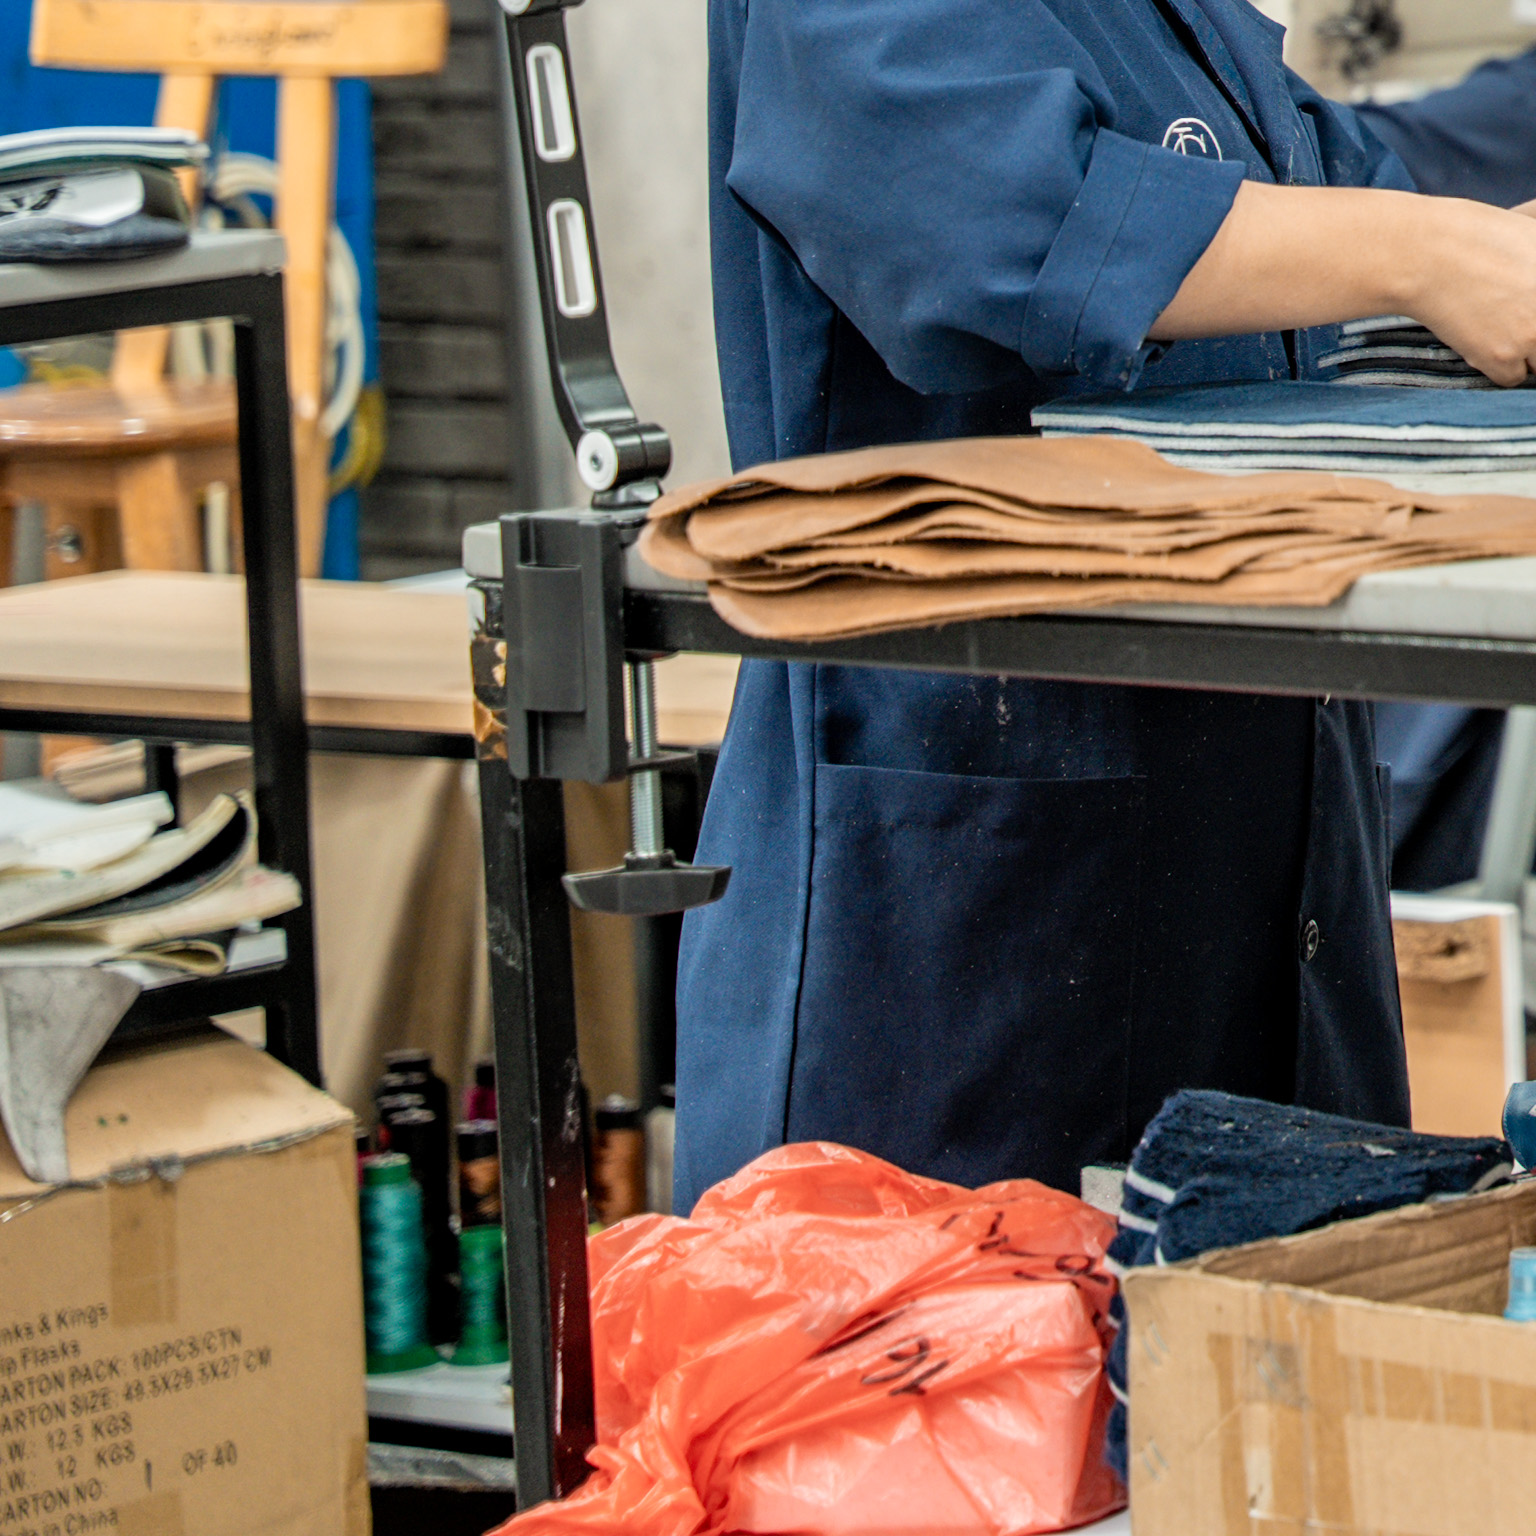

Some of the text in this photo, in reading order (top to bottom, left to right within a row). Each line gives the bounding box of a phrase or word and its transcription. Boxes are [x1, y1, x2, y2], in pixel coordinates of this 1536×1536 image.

[56, 1303, 108, 1329] Kings
[244, 1344, 272, 1372] CM
[91, 1411, 133, 1441] KGS
[95, 1439, 136, 1468] KGS
[182, 1449, 208, 1476] OF
[64, 1507, 119, 1536] China
